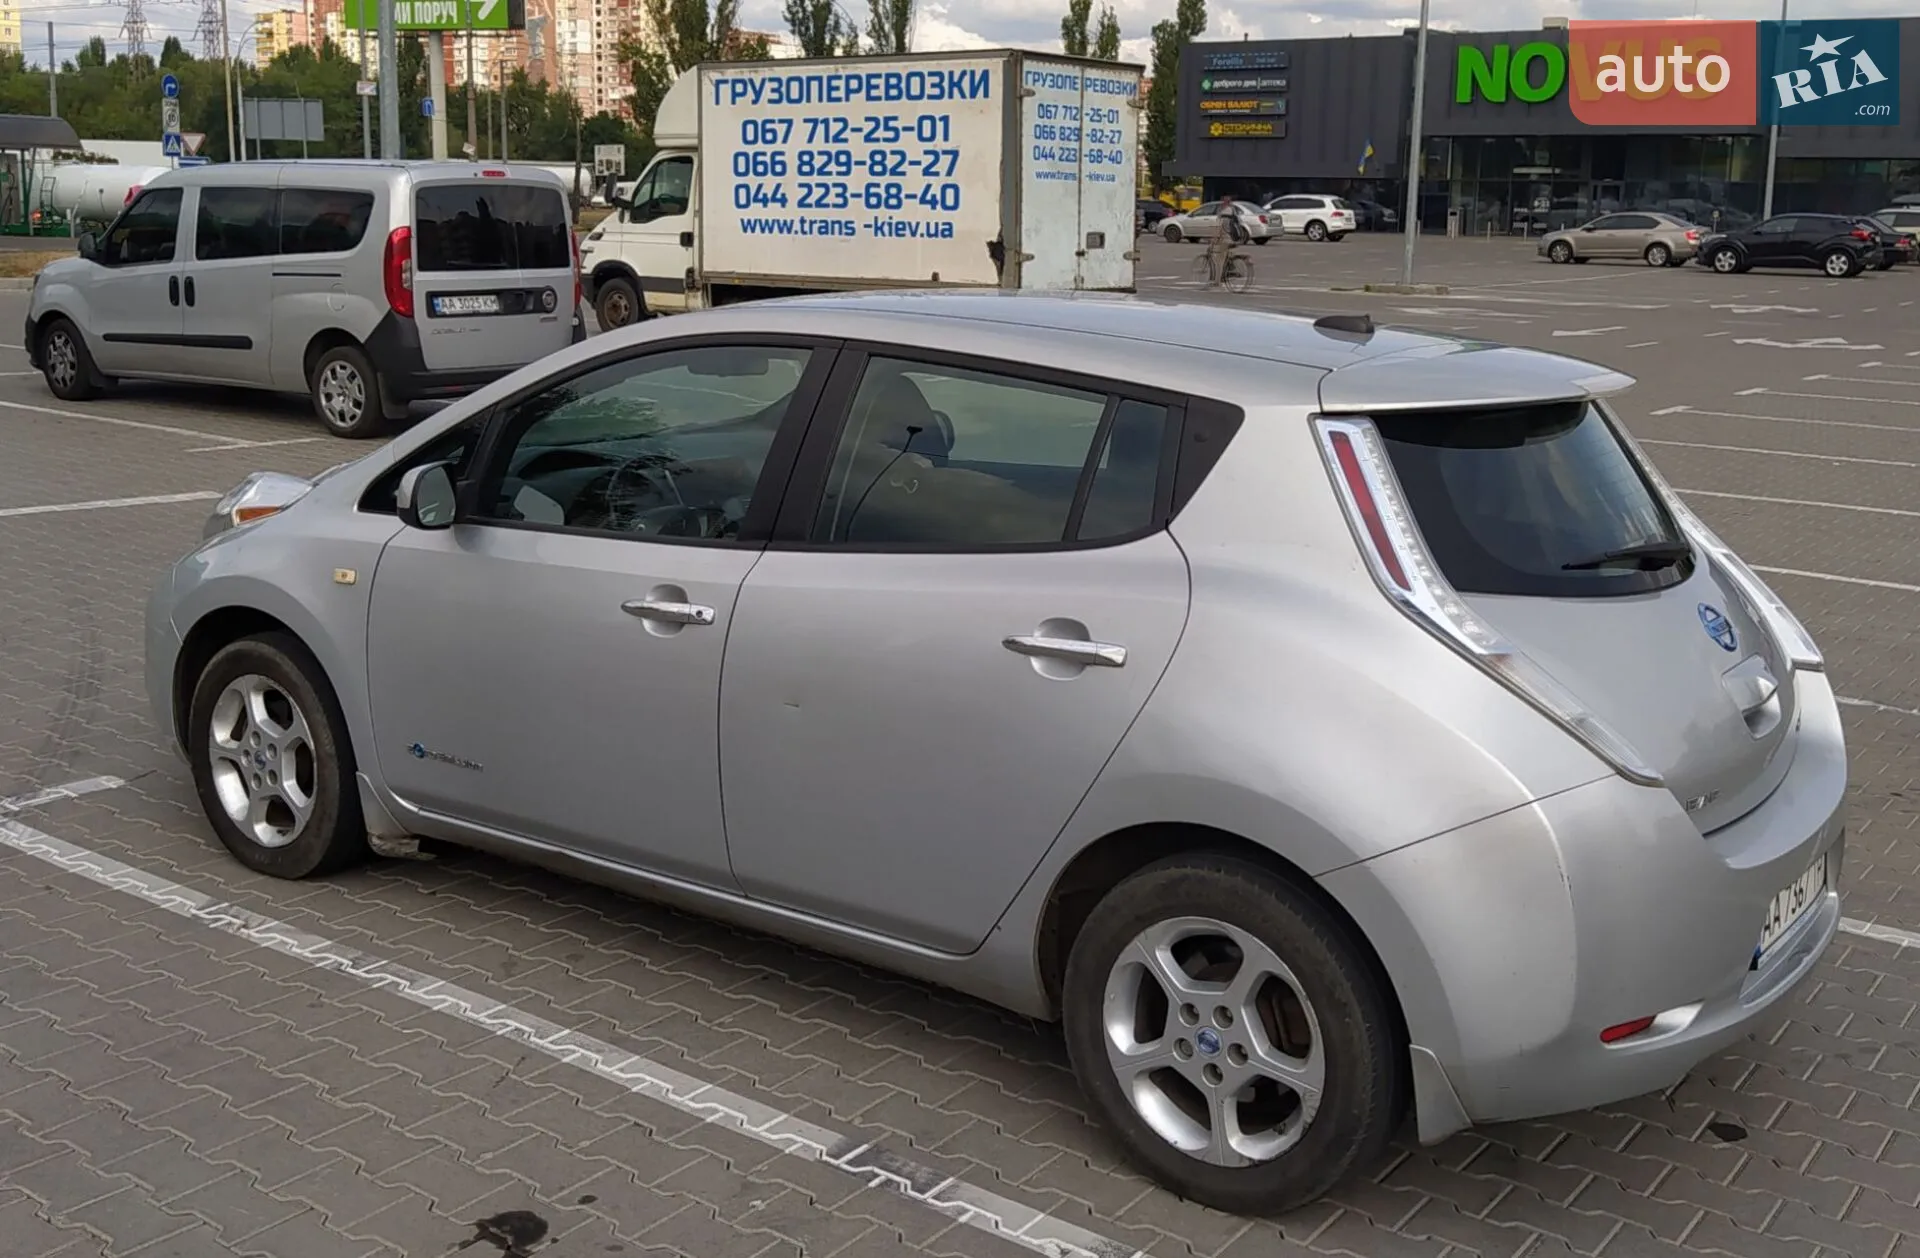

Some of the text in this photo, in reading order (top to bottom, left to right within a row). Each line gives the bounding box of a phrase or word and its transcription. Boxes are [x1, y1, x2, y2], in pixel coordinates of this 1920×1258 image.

[414, 1, 458, 25] ПОРУЧ
[714, 68, 991, 106] ГРУЗОПЕРЕВОЗКИ
[1037, 103, 1059, 120] 067
[741, 114, 951, 146] 067 712-25-01
[1033, 124, 1057, 141] 066
[732, 148, 961, 178] 066 829-82-27
[1033, 145, 1056, 161] 044
[733, 182, 961, 212] 044 223-68-40
[740, 215, 955, 239] www.trans -kiev.ua
